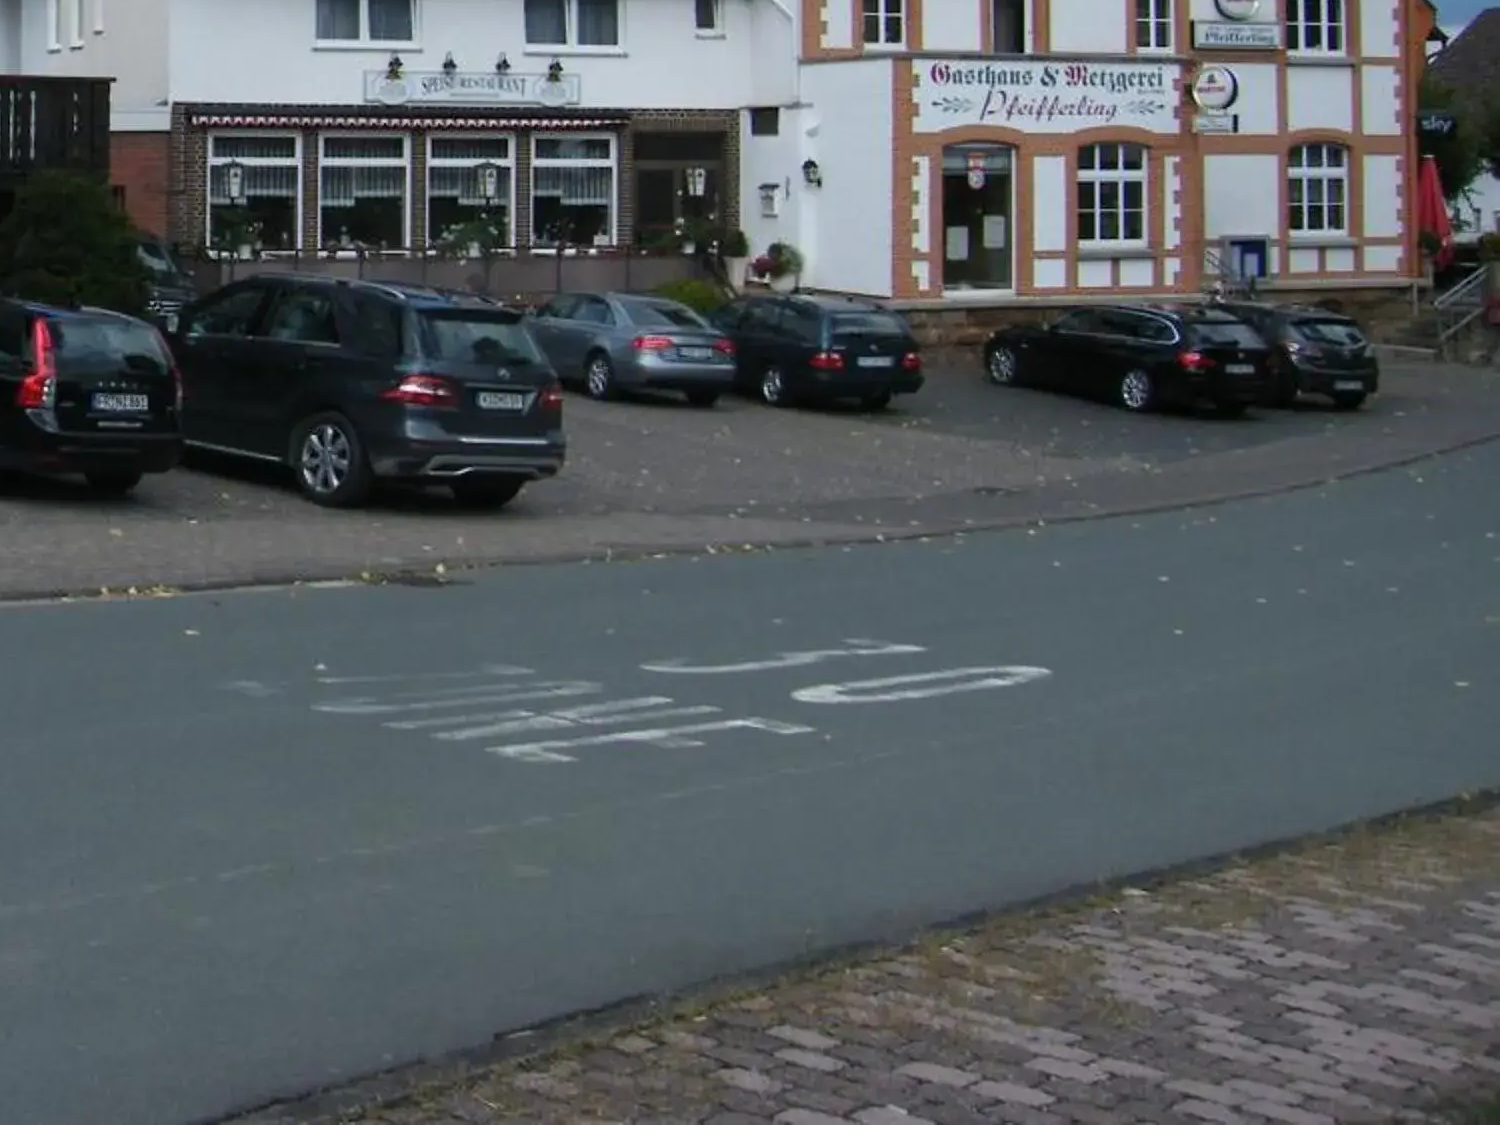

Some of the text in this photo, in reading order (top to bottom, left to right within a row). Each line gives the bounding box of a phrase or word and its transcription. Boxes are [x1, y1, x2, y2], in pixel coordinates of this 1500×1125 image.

[931, 62, 1033, 88] Gasthaus
[1064, 64, 1163, 93] Metzgerei
[980, 89, 1117, 123] Pfeifferling
[1421, 114, 1453, 133] sky
